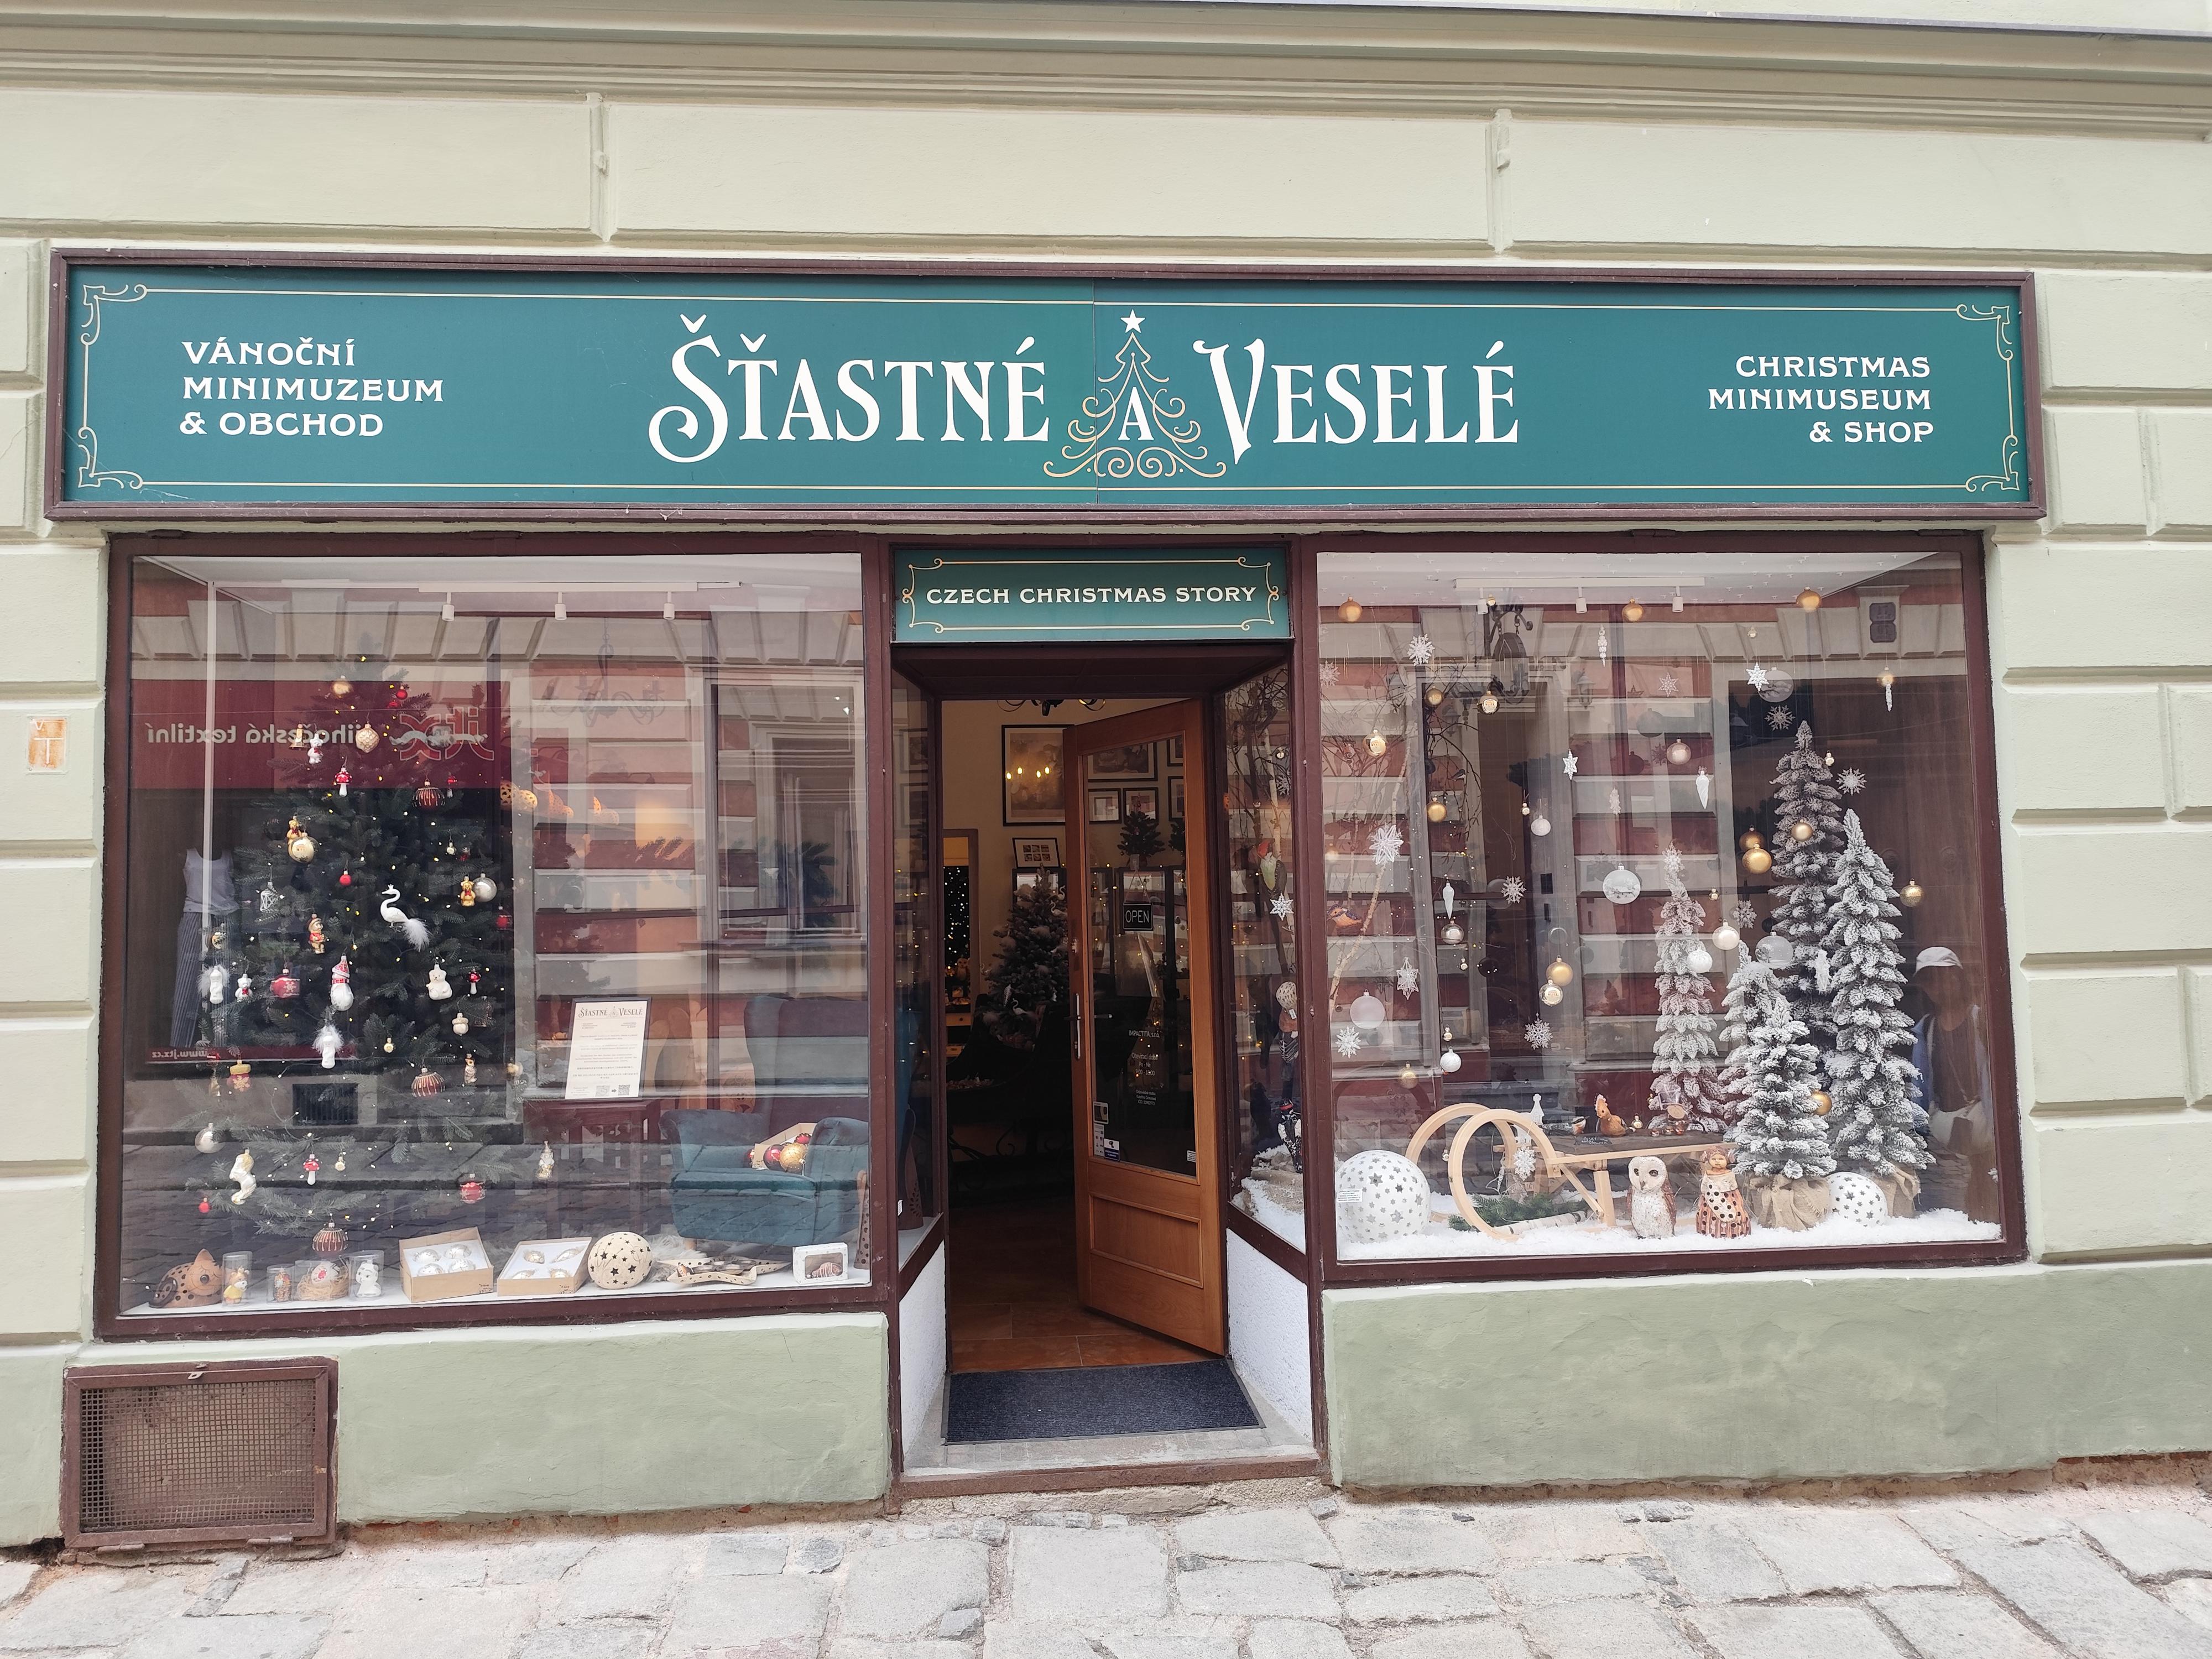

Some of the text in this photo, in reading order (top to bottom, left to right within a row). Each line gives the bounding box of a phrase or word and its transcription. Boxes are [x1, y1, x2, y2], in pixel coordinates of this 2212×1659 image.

[181, 336, 355, 366] VÁNOČNÍ
[1735, 356, 1931, 378] CHRISTMAS
[182, 377, 444, 402] MINIMUZEUM
[649, 314, 1519, 465] ŠŤASTNÉ A VESELÉ
[1708, 389, 1931, 410] MINIMUSEUM
[180, 411, 383, 436] & OBCHOD
[1809, 421, 1933, 443] & SHOP
[926, 587, 1256, 604] CZECH CHRISTMAS STORY
[1125, 910, 1150, 923] OPEN
